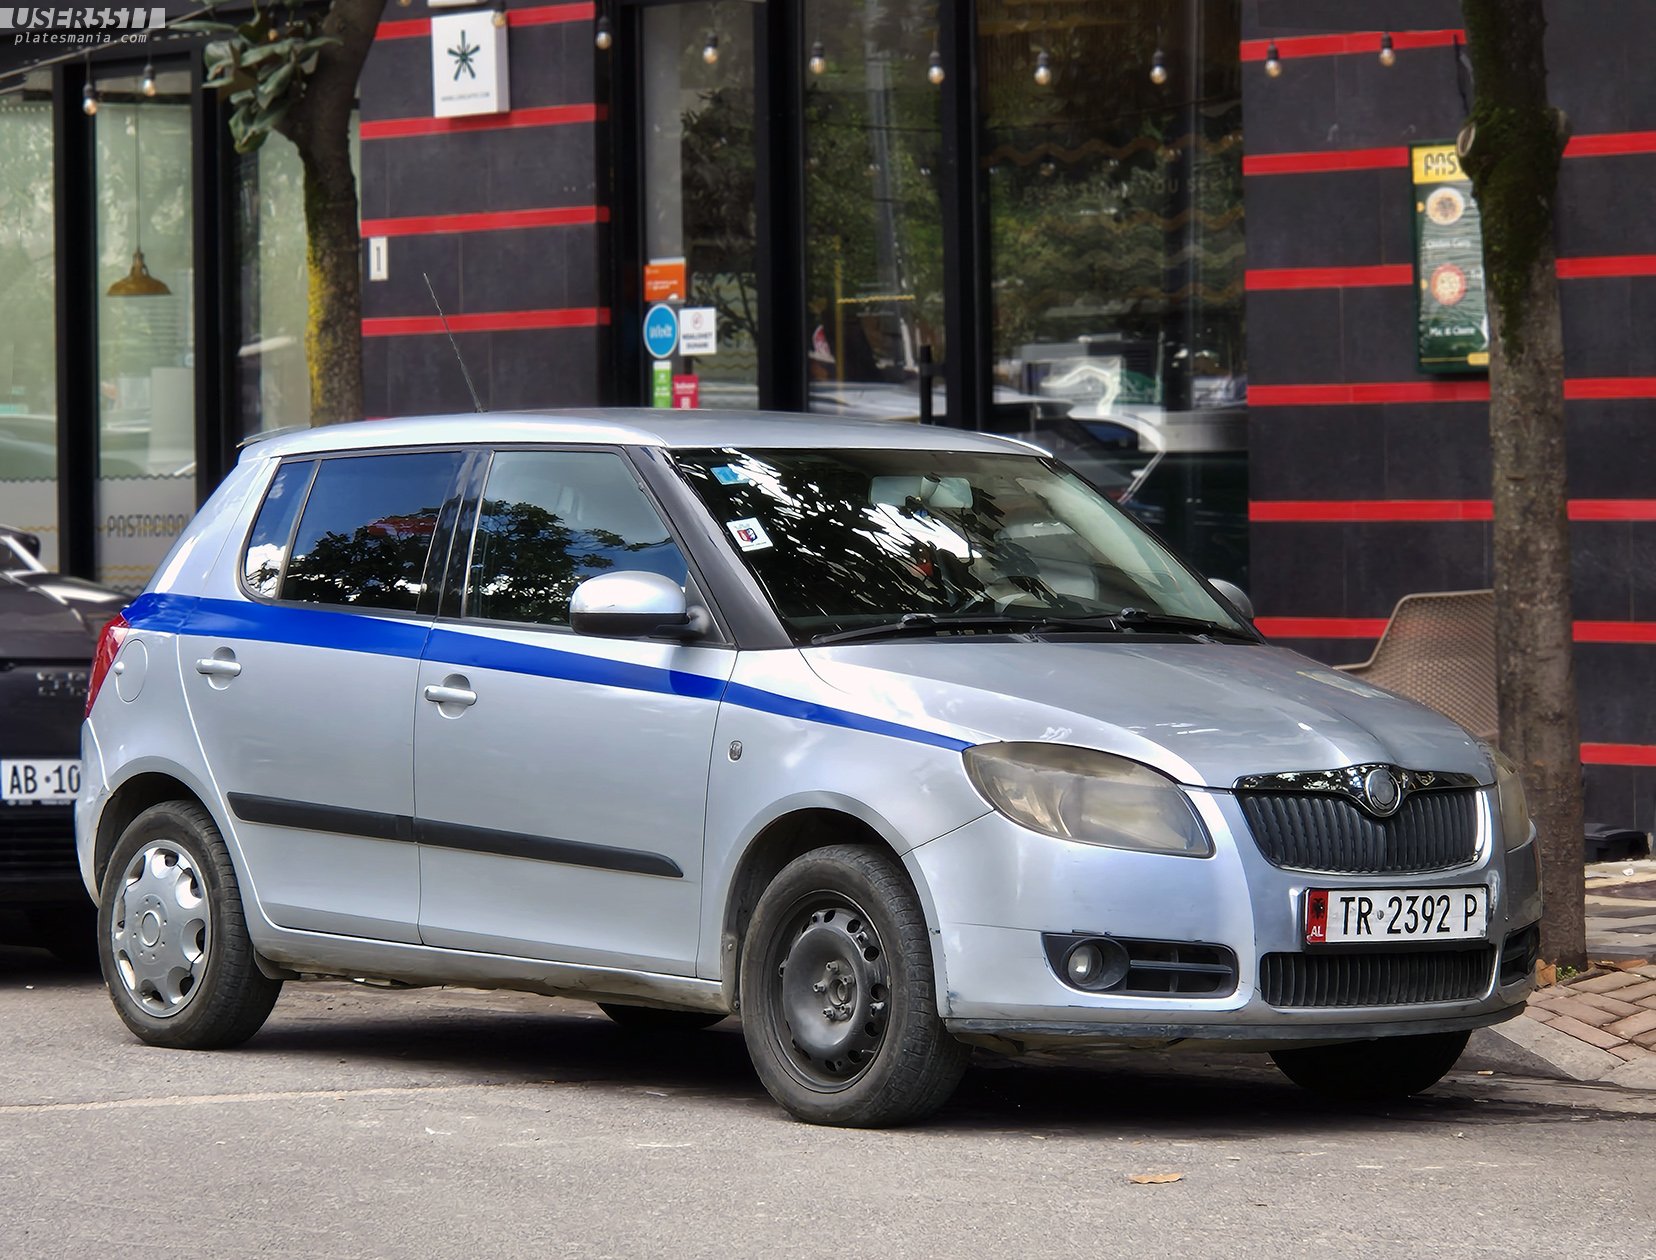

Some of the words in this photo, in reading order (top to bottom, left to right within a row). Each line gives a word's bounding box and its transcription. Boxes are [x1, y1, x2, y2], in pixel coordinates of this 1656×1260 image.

[1424, 151, 1458, 177] PAS
[10, 764, 38, 794] AB
[52, 764, 81, 794] 10
[1339, 896, 1372, 936] TR
[1386, 895, 1451, 935] 2392
[1464, 894, 1478, 932] P
[1310, 925, 1324, 937] AL
